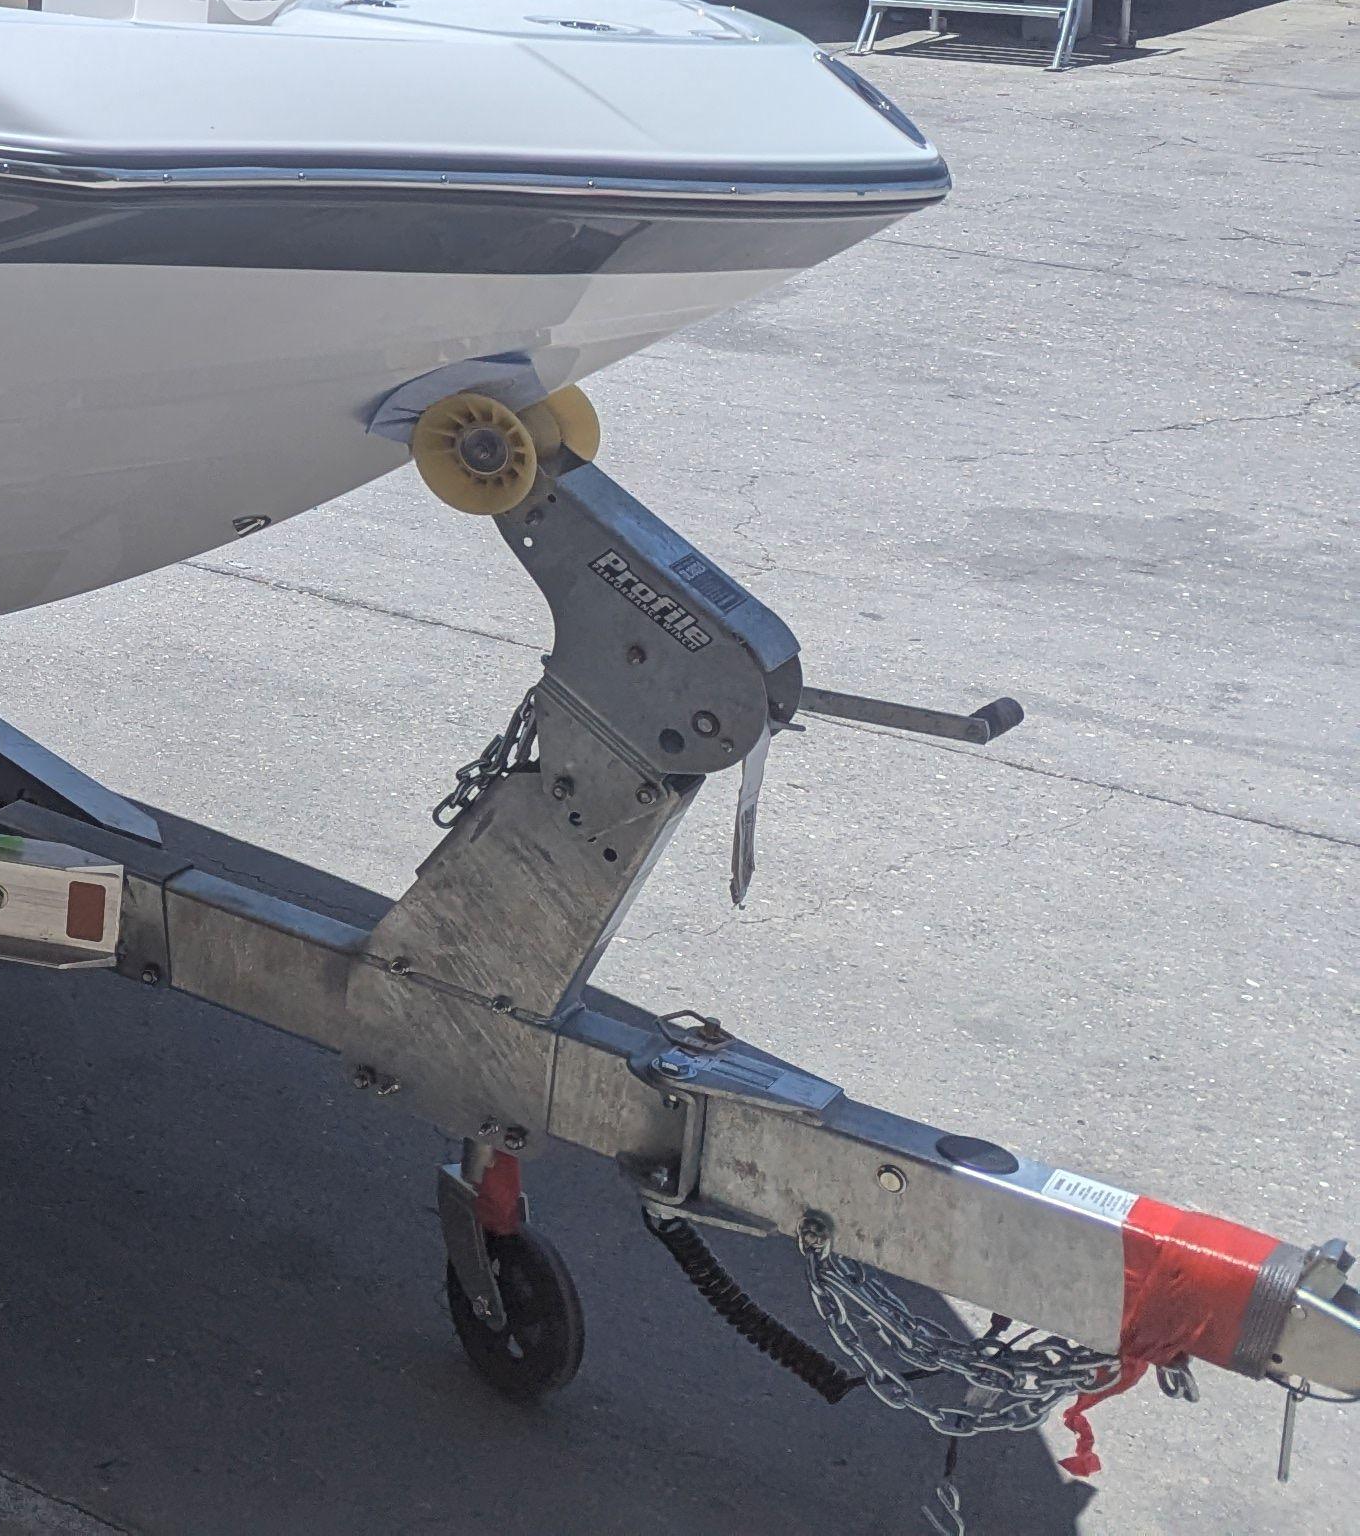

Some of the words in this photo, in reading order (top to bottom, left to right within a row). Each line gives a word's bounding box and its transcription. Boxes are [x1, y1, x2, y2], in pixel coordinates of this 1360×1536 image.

[592, 563, 663, 622] PERFORMANCE
[663, 621, 701, 650] WINCH
[596, 551, 710, 647] Profile
